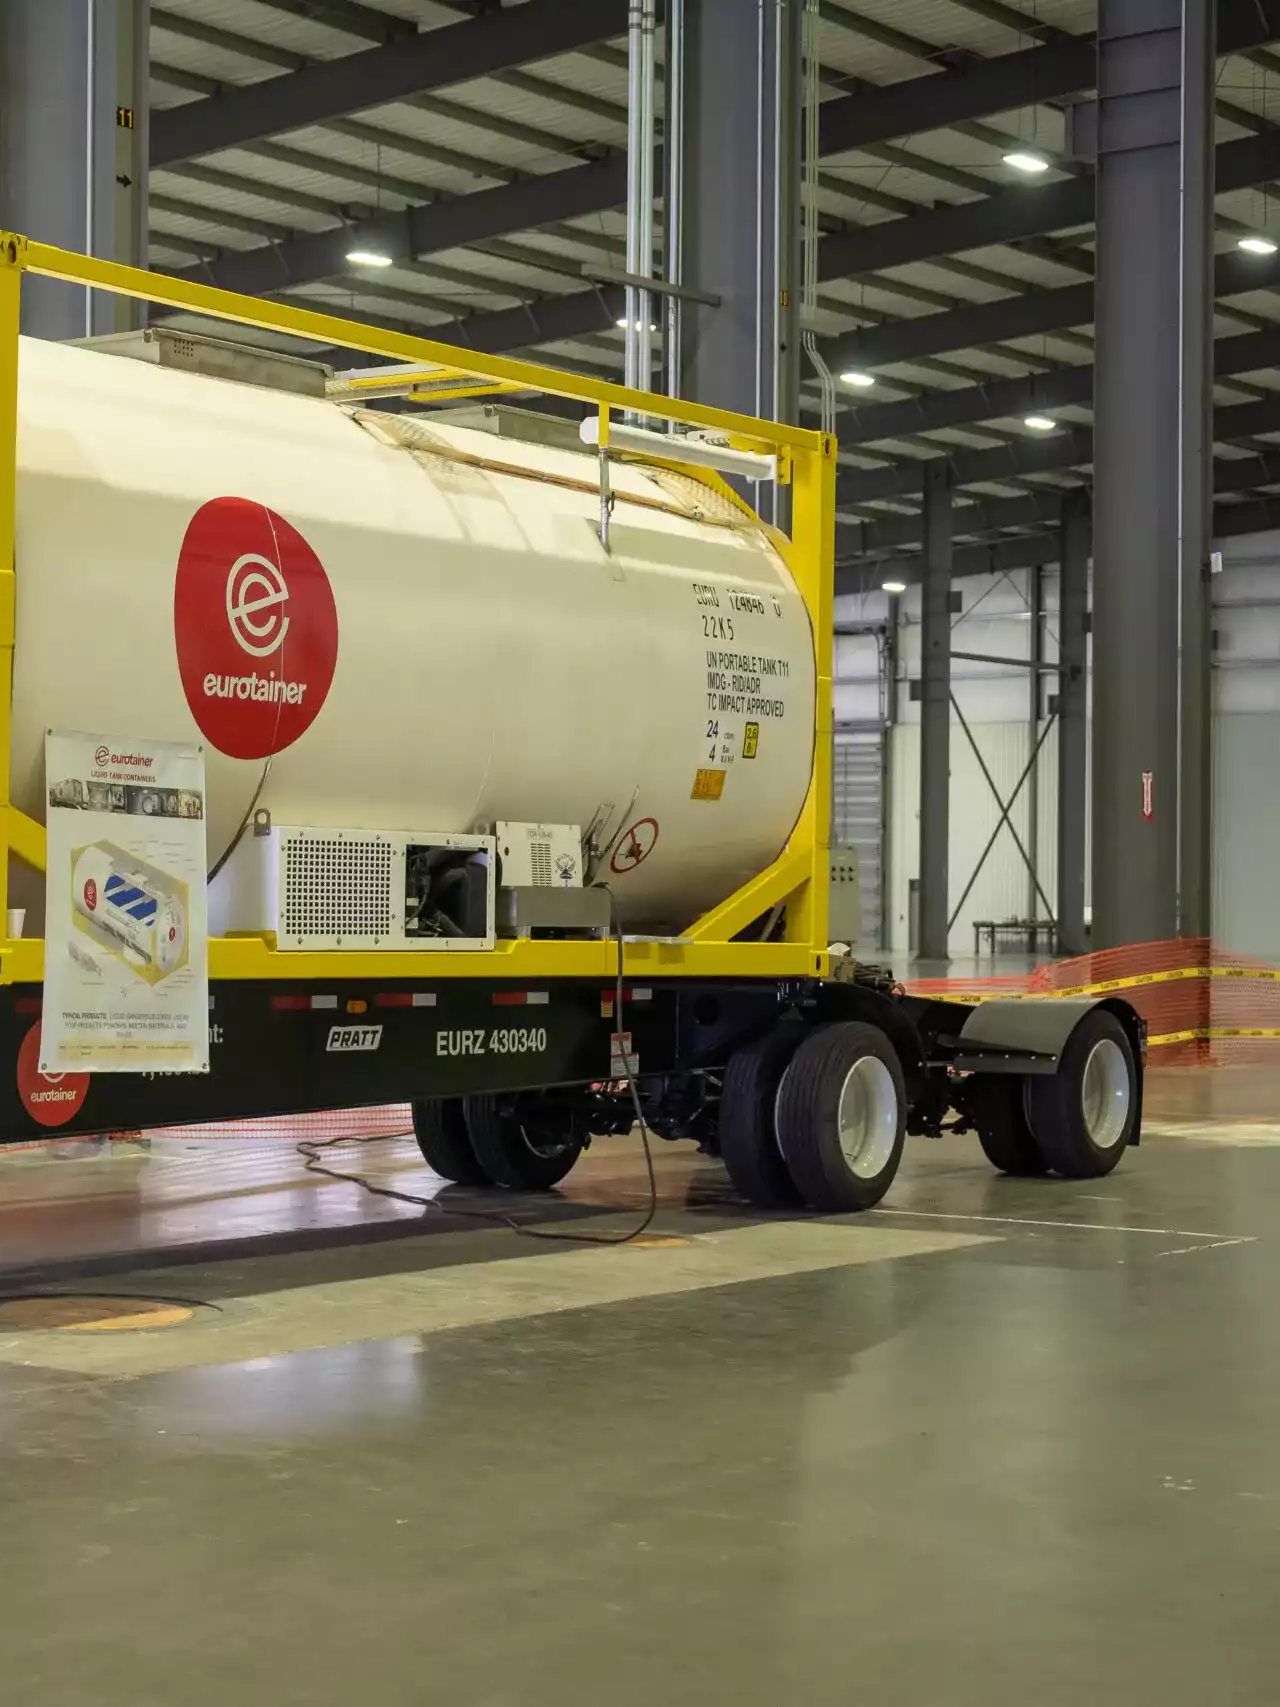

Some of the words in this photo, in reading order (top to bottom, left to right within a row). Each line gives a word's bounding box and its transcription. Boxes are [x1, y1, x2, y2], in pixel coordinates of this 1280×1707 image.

[120, 108, 133, 128] 11
[692, 583, 720, 607] EURU
[702, 614, 734, 641] 22K5
[706, 650, 718, 669] UN
[718, 652, 757, 673] PORTABLE
[758, 656, 777, 676] TANK
[777, 659, 789, 678] T11
[203, 671, 307, 705] eurotainer
[707, 671, 726, 690] IMDG
[707, 693, 717, 711] TC
[718, 694, 746, 713] IMPACT
[746, 697, 785, 718] APPROVED
[706, 719, 719, 739] 24
[110, 752, 154, 767] eurotainer
[708, 743, 716, 762] 4
[109, 771, 123, 780] TANK
[123, 773, 156, 783] CONTAINERS
[329, 1030, 380, 1047] PRATT
[436, 1029, 486, 1056] EURZ
[489, 1028, 547, 1054] 430340
[30, 1088, 77, 1103] eurotainer
